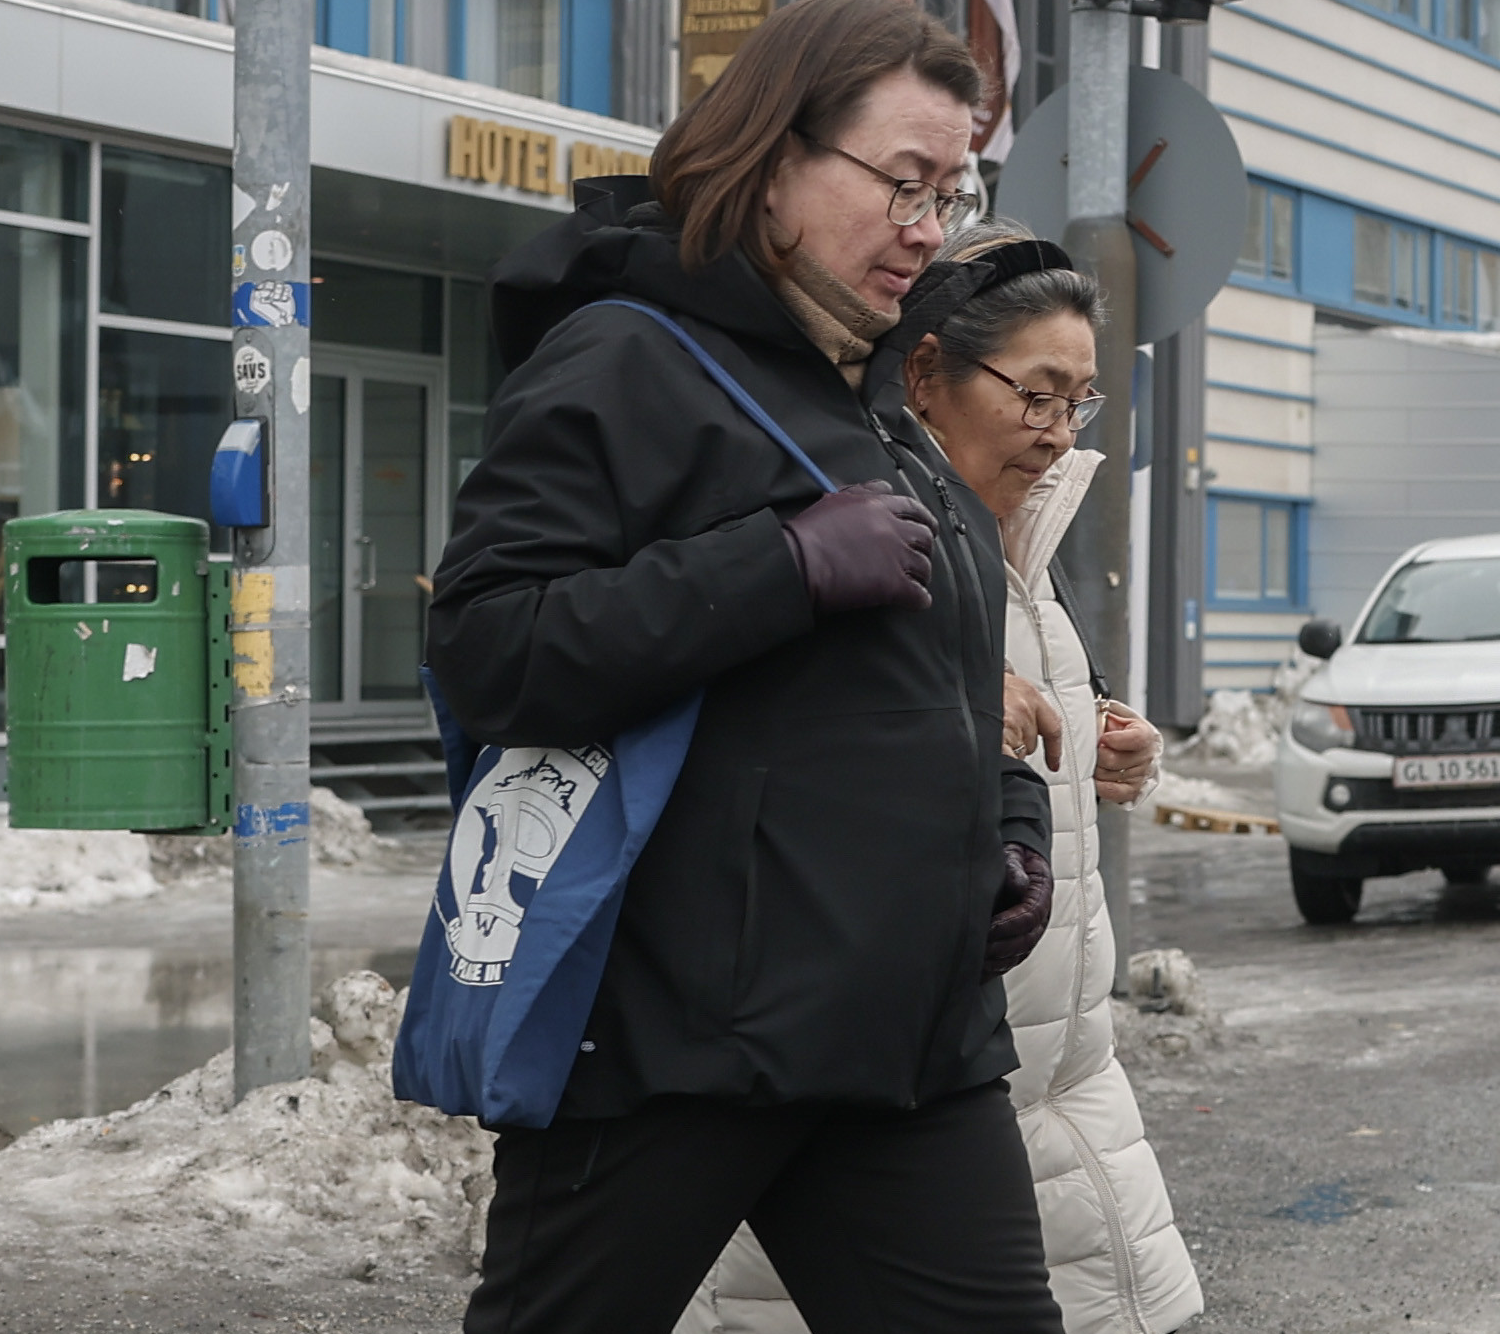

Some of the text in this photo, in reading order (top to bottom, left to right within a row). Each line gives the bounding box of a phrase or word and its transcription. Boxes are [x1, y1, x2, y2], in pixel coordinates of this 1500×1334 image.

[448, 115, 566, 197] HOTEL
[1403, 758, 1500, 782] GL 10 561
